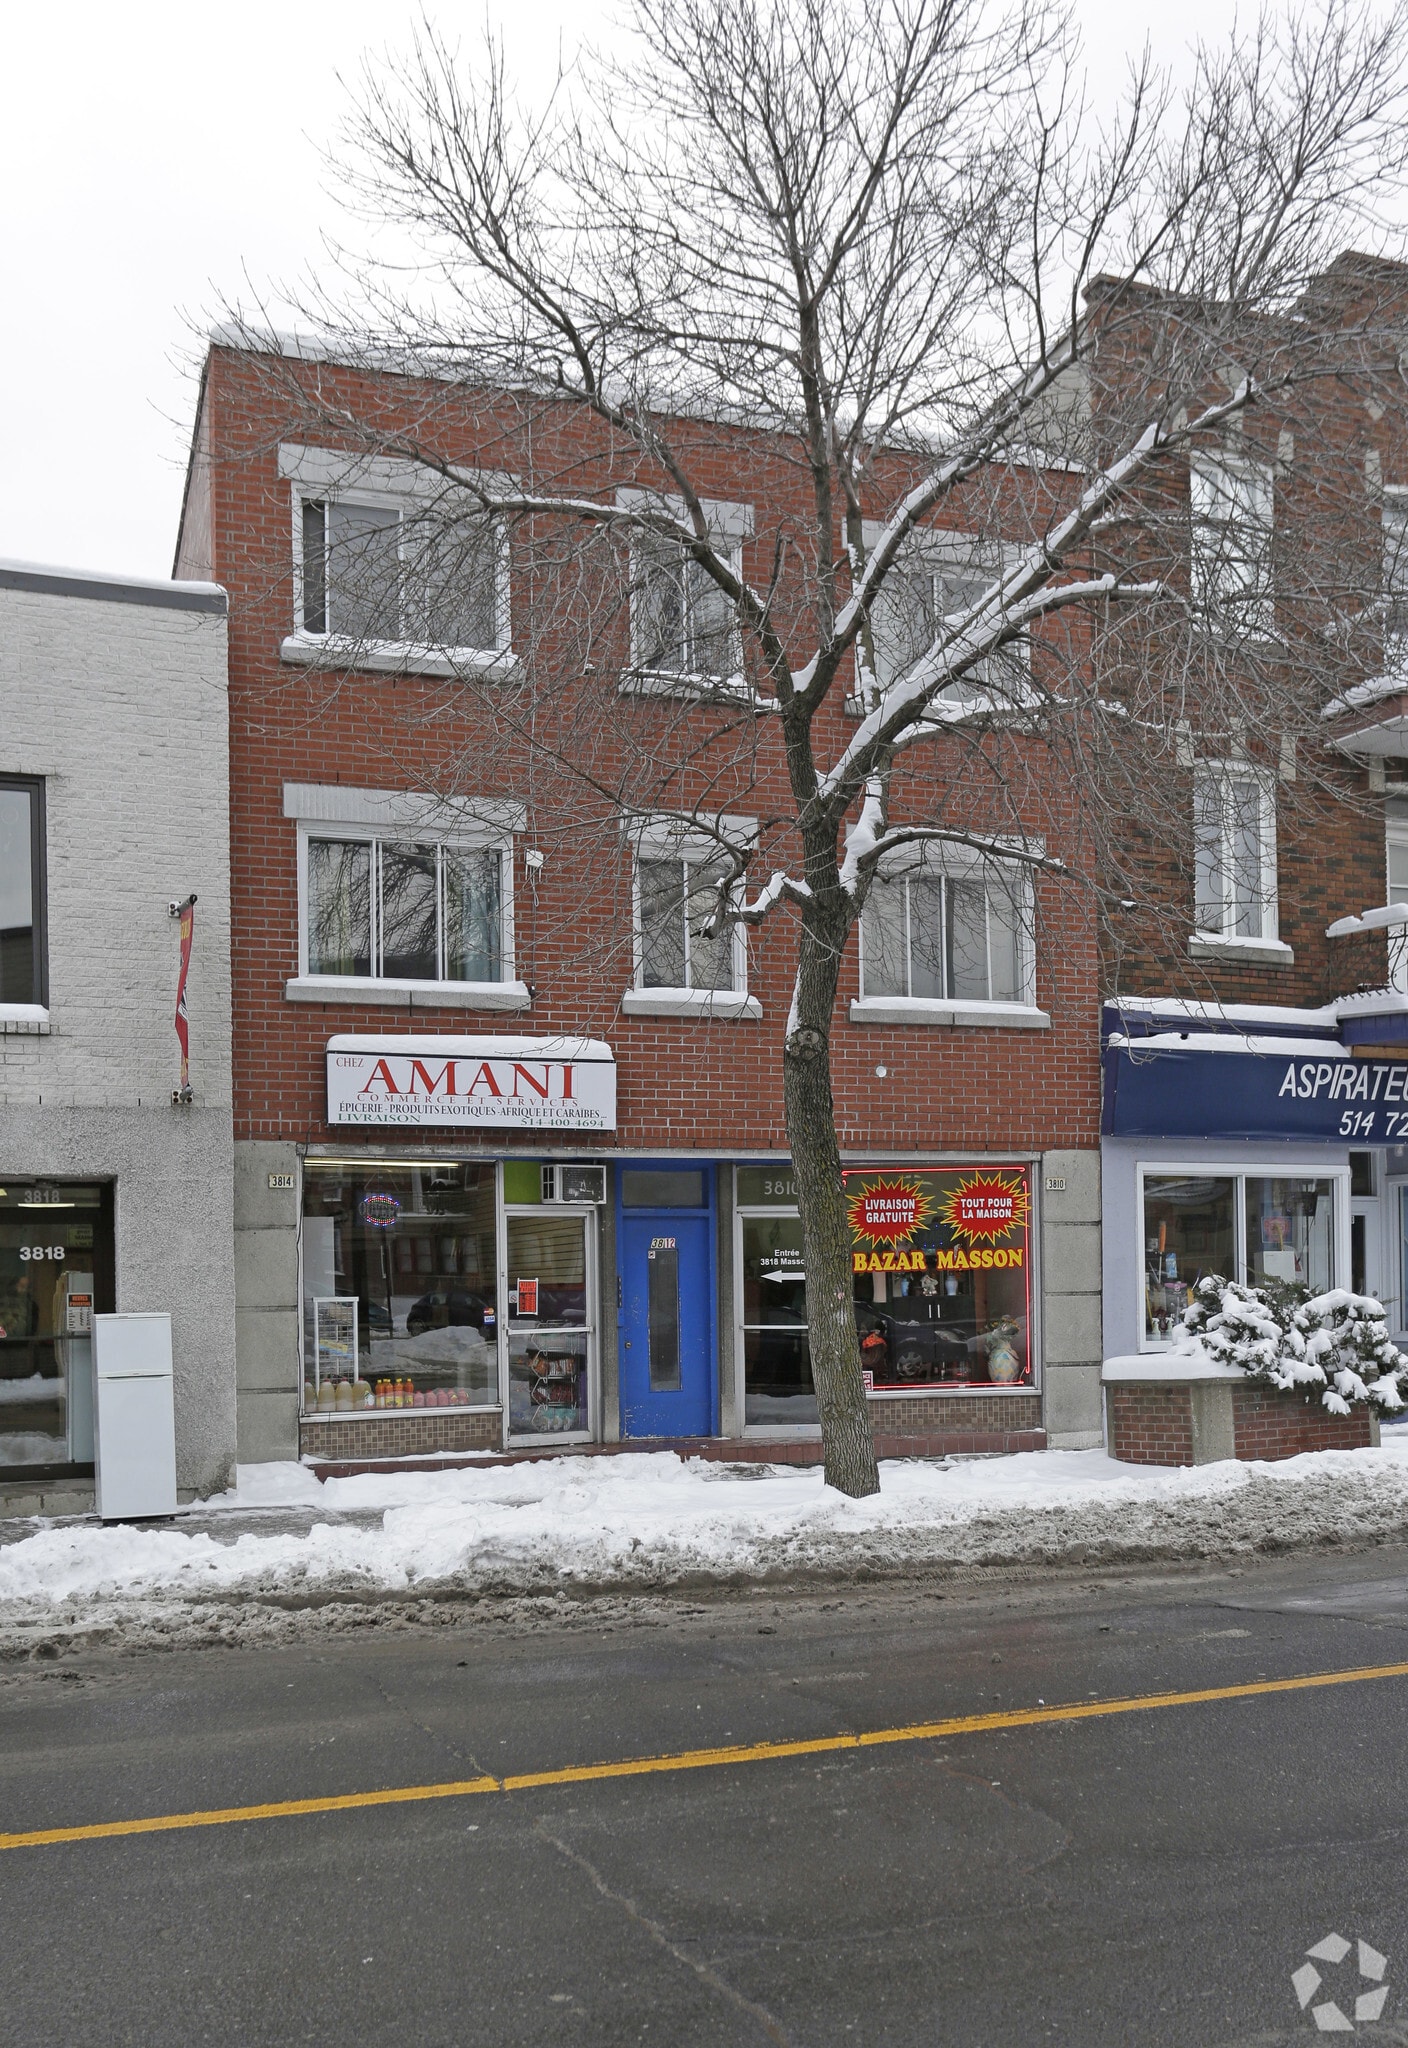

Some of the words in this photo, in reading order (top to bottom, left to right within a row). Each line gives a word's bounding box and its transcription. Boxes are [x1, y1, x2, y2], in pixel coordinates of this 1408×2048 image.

[336, 1057, 364, 1068] CHEZ
[358, 1058, 578, 1099] AMANI
[357, 1093, 457, 1104] COMMERCE
[467, 1097, 486, 1105] ET
[497, 1097, 579, 1107] SERVICES
[340, 1101, 383, 1113] ÉPICERIE
[390, 1104, 440, 1114] PRODUITS
[441, 1105, 496, 1117] EXOTIQUES
[542, 1108, 554, 1117] ET
[338, 1113, 421, 1123] LIVRAISON
[520, 1118, 604, 1128] 514-400-4694
[1339, 1111, 1375, 1136] 514
[272, 1176, 291, 1187] 3814
[1049, 1180, 1064, 1189] 3810
[24, 1190, 60, 1203] 3818
[865, 1199, 915, 1210] LIVRAISON
[961, 1199, 985, 1208] TOUT
[987, 1198, 1013, 1208] POUR
[866, 1212, 914, 1223] GRATUITE
[962, 1209, 974, 1219] LA
[976, 1208, 1012, 1219] MAISON
[651, 1238, 675, 1248] 3812
[19, 1246, 65, 1260] 3818
[774, 1249, 800, 1257] Entrée
[760, 1258, 779, 1266] 3818
[853, 1252, 927, 1272] BAZAR
[937, 1249, 1023, 1270] MASSON
